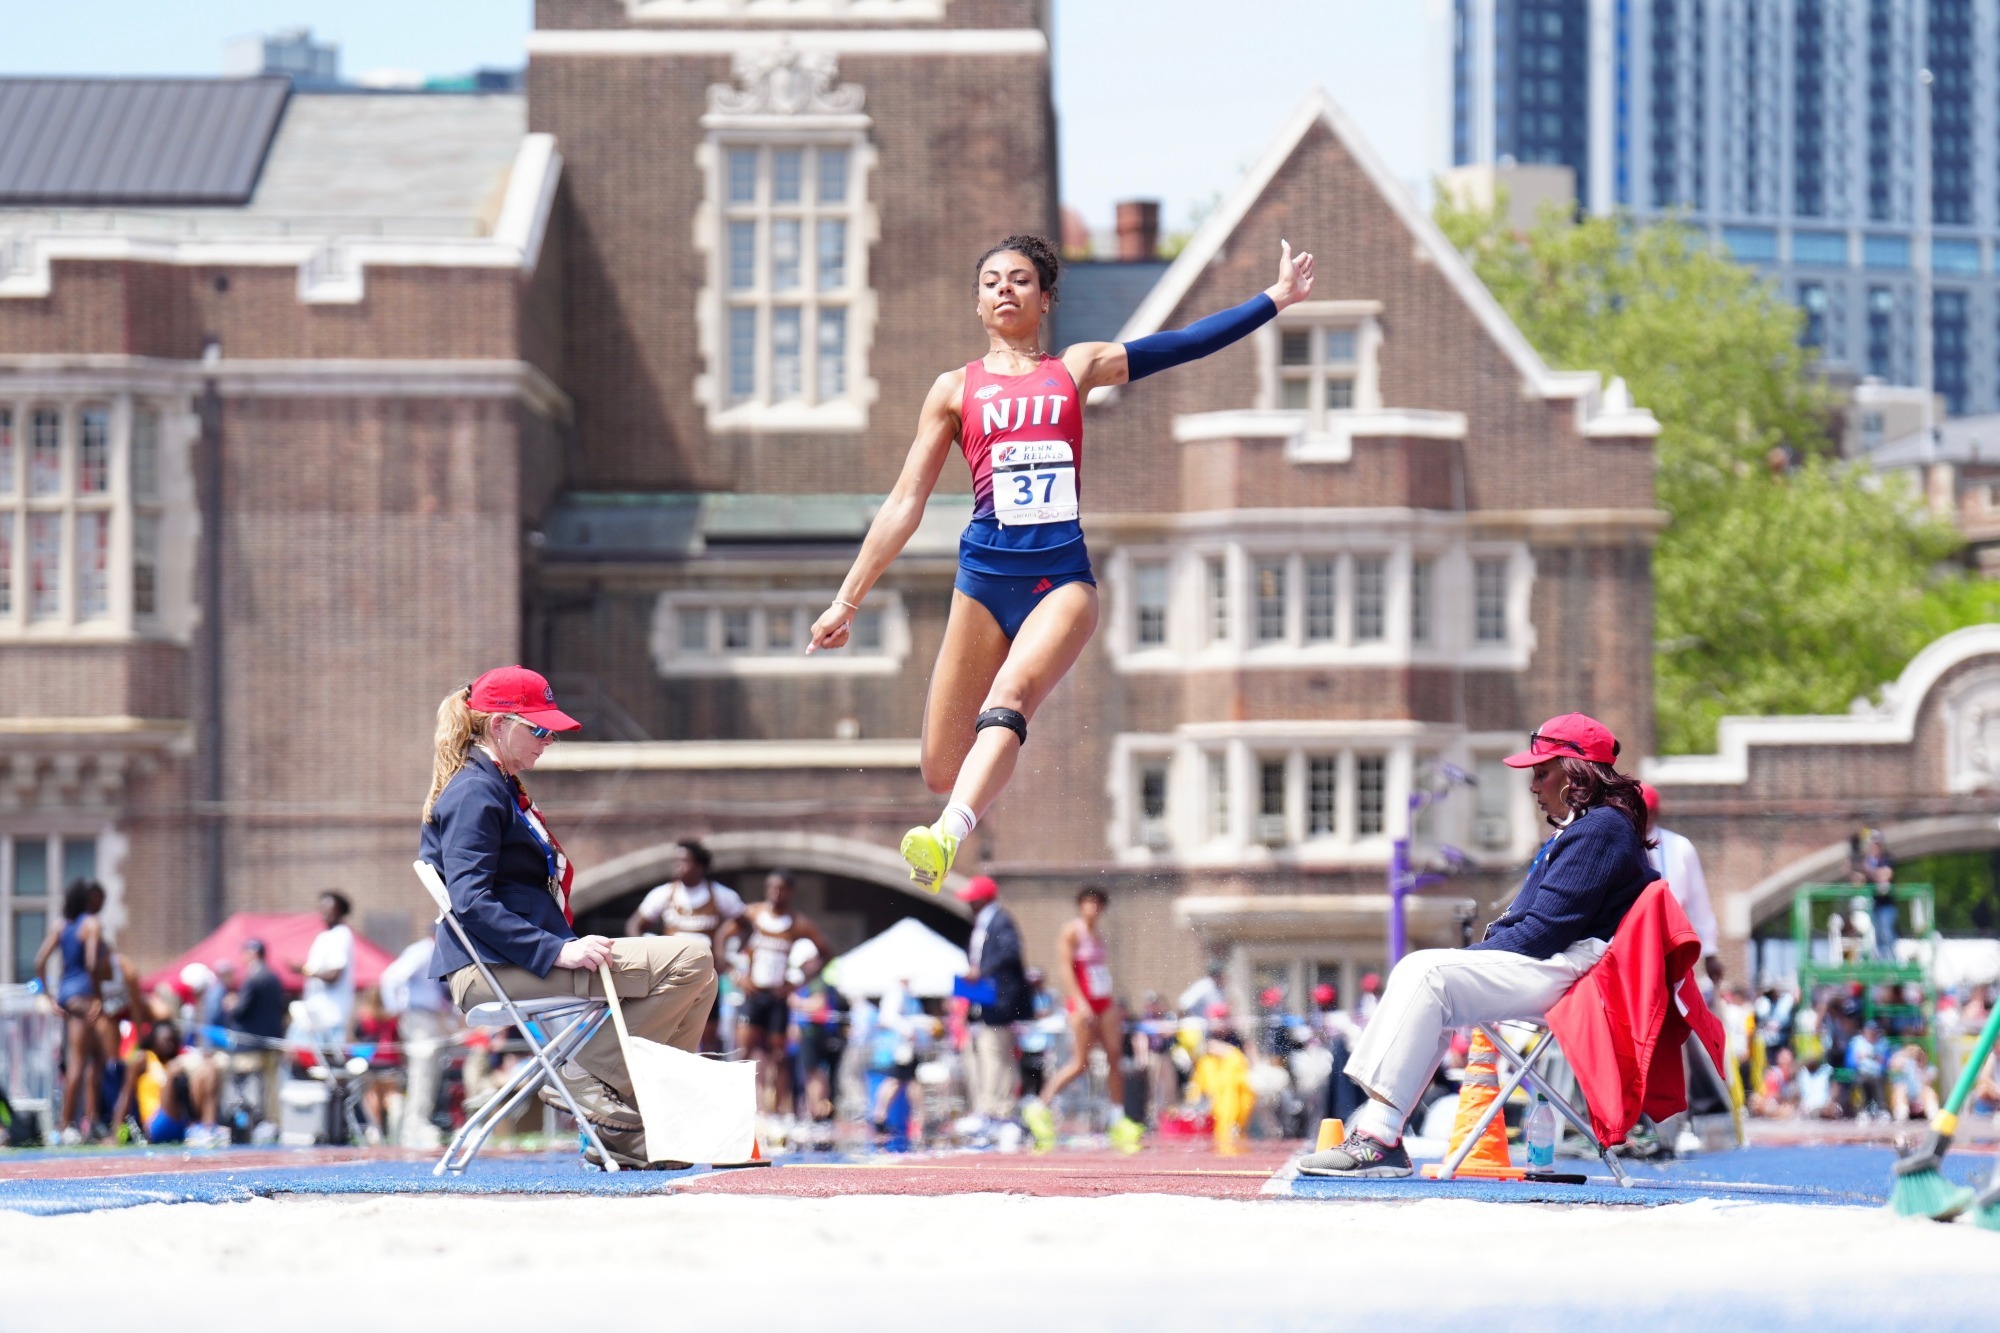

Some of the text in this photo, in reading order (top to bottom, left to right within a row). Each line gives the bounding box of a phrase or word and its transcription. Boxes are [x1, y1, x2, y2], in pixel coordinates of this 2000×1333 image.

[982, 395, 1068, 437] NJIT
[1023, 451, 1064, 461] RELAYS
[1024, 444, 1053, 452] PENN
[1012, 473, 1056, 505] 37
